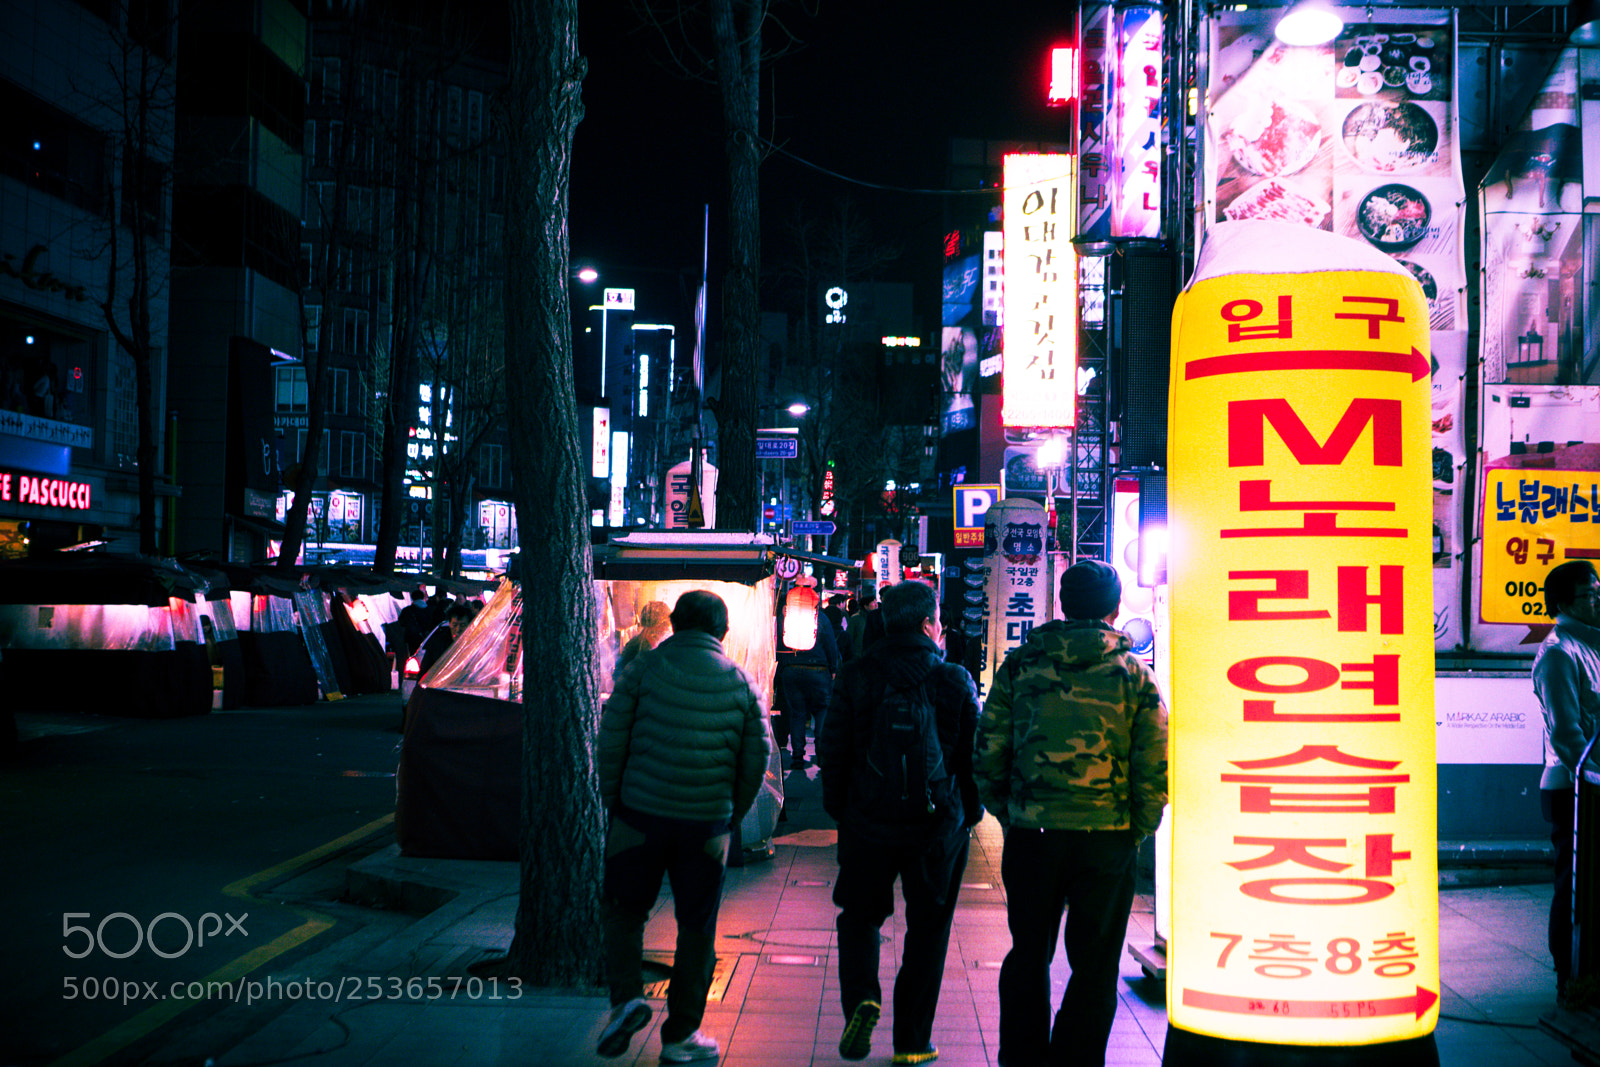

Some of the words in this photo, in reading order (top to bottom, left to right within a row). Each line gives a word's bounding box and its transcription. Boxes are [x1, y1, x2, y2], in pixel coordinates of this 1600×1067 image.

[1022, 187, 1058, 380] 이대감고깃집
[19, 475, 91, 510] PASCUCCI
[963, 490, 991, 526] P
[1506, 537, 1555, 565] 입구
[1005, 567, 1038, 576] 국일관
[1490, 712, 1526, 722] ARABIC
